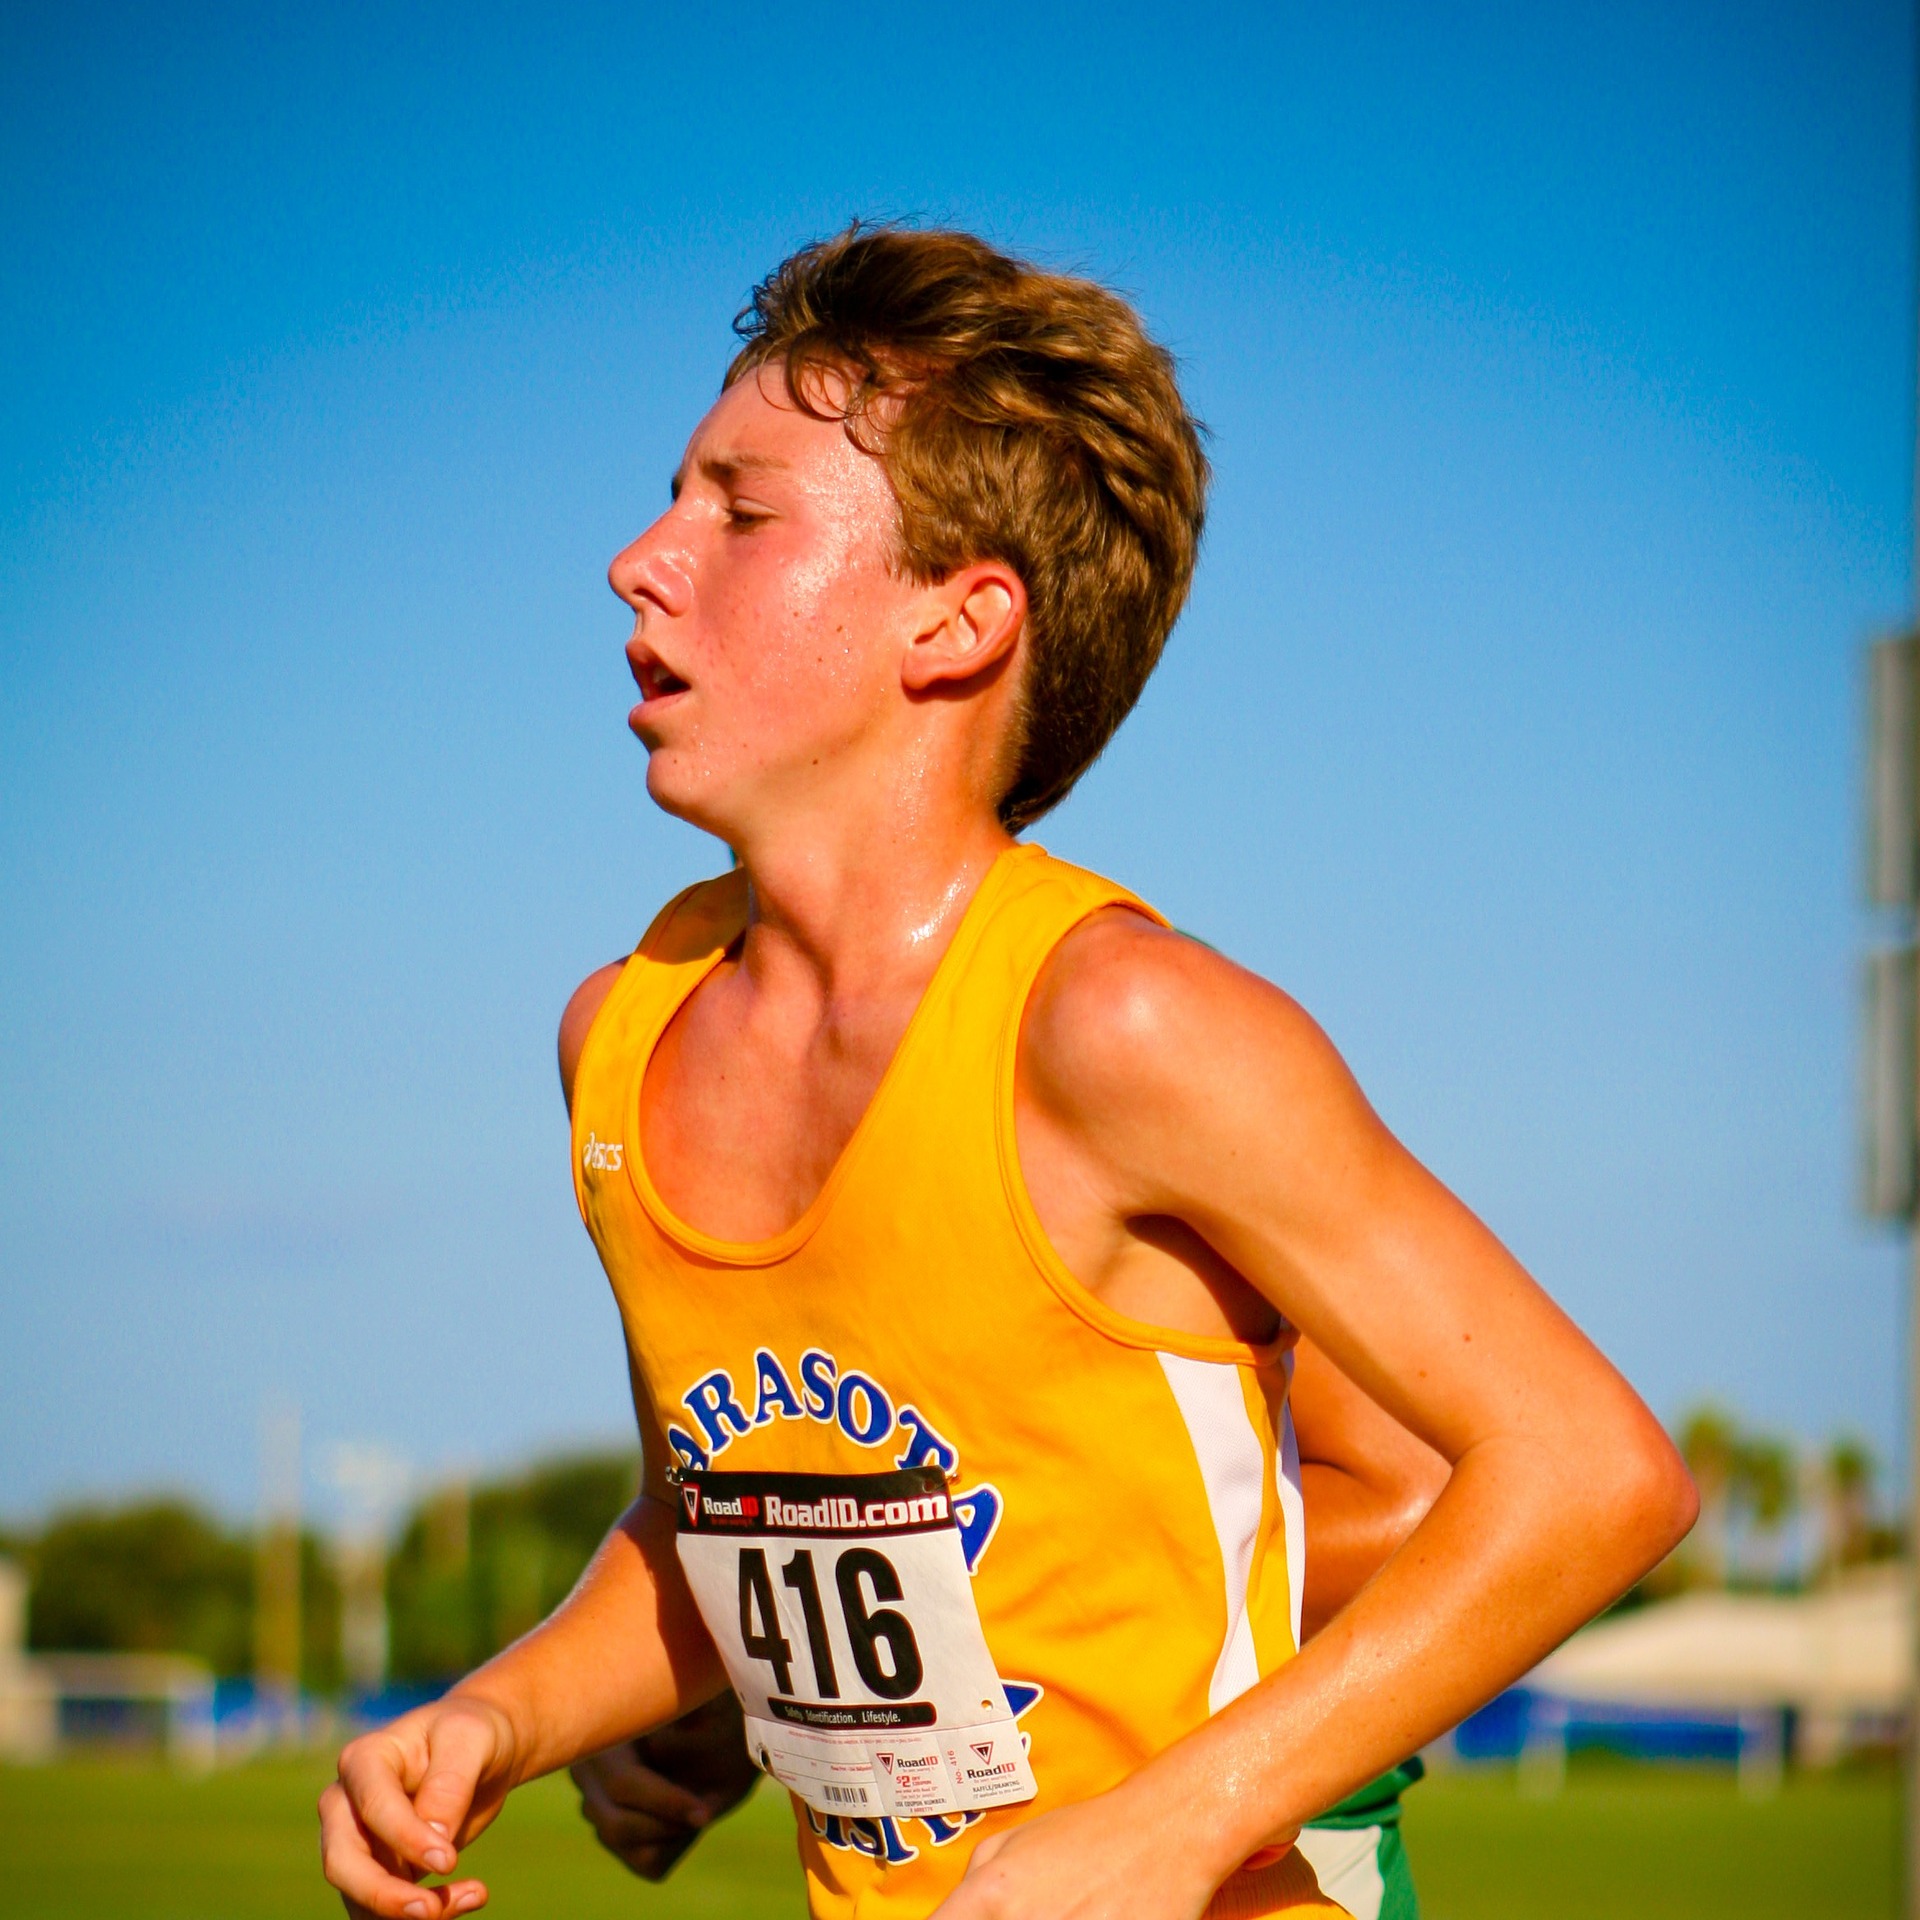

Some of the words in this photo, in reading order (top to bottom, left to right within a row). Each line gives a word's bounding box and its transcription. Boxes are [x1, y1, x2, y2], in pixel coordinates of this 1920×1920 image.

[764, 1495, 949, 1528] RoadID.com
[738, 1547, 924, 1700] 416
[861, 1710, 901, 1726] Lifestyle.
[896, 1755, 939, 1768] RoadID
[947, 1750, 957, 1766] 416
[966, 1762, 1016, 1779] RoadID
